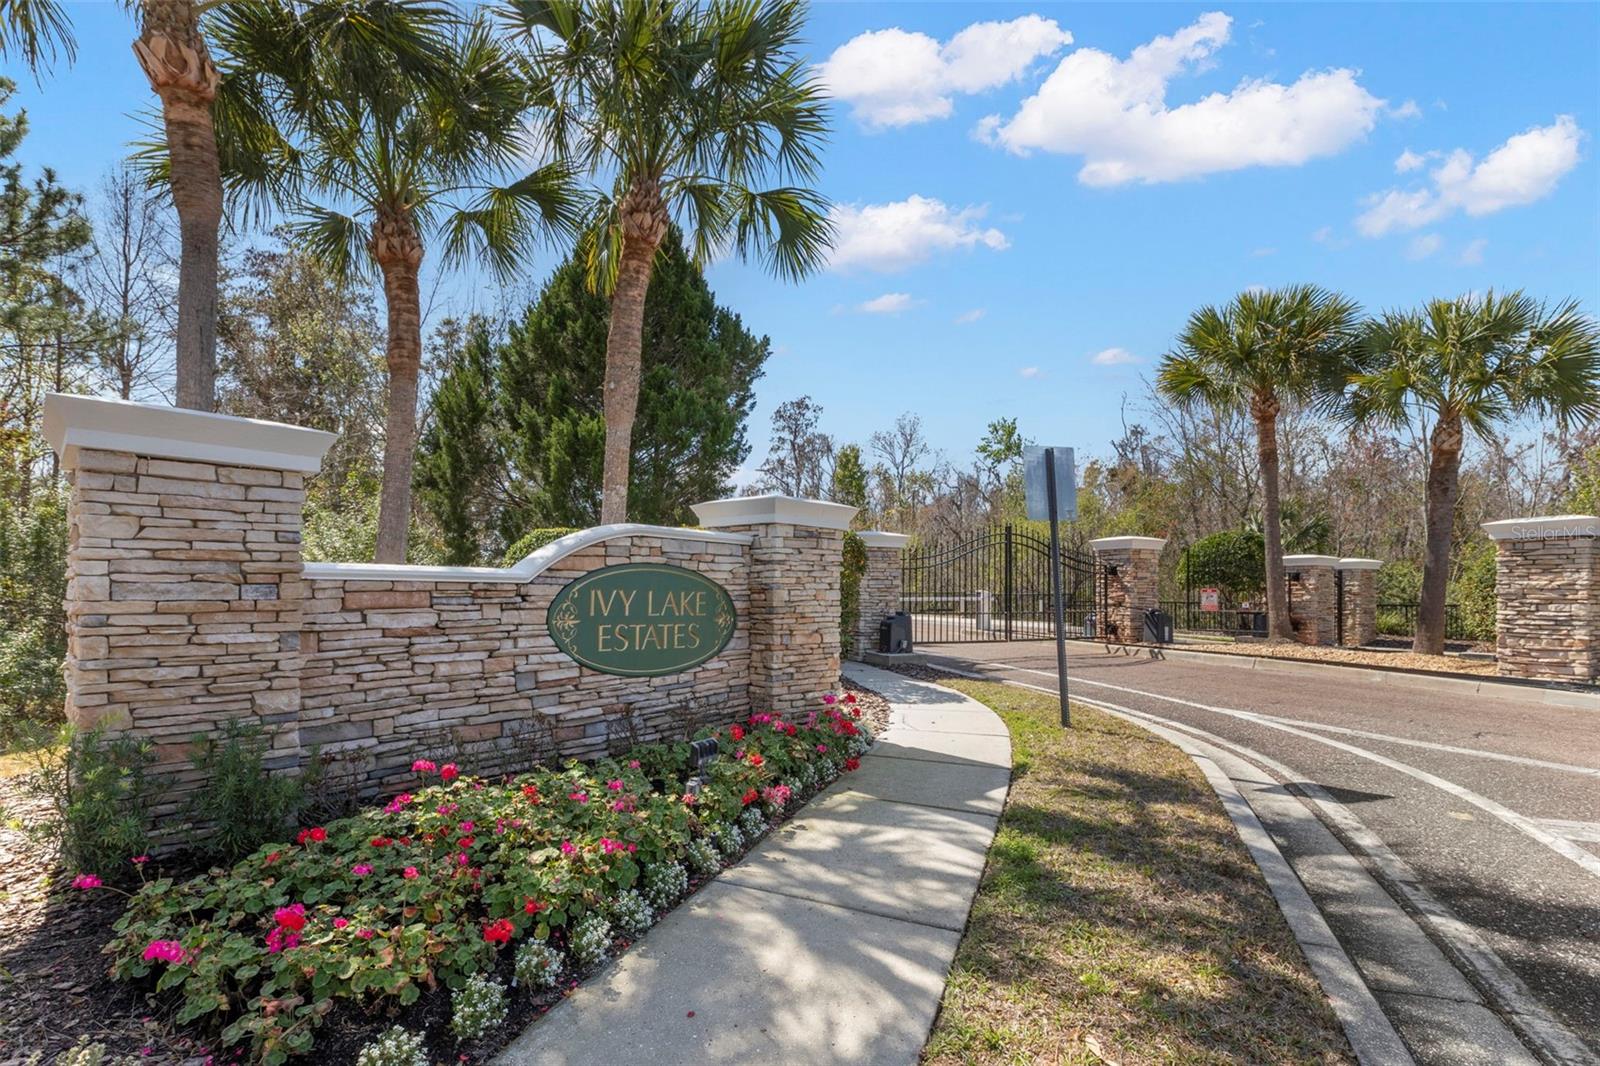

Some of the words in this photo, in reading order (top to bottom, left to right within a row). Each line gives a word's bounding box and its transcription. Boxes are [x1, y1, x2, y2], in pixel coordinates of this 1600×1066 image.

[589, 590, 637, 617] IVY
[648, 591, 706, 617] LAKE
[598, 623, 700, 652] ESTATES
